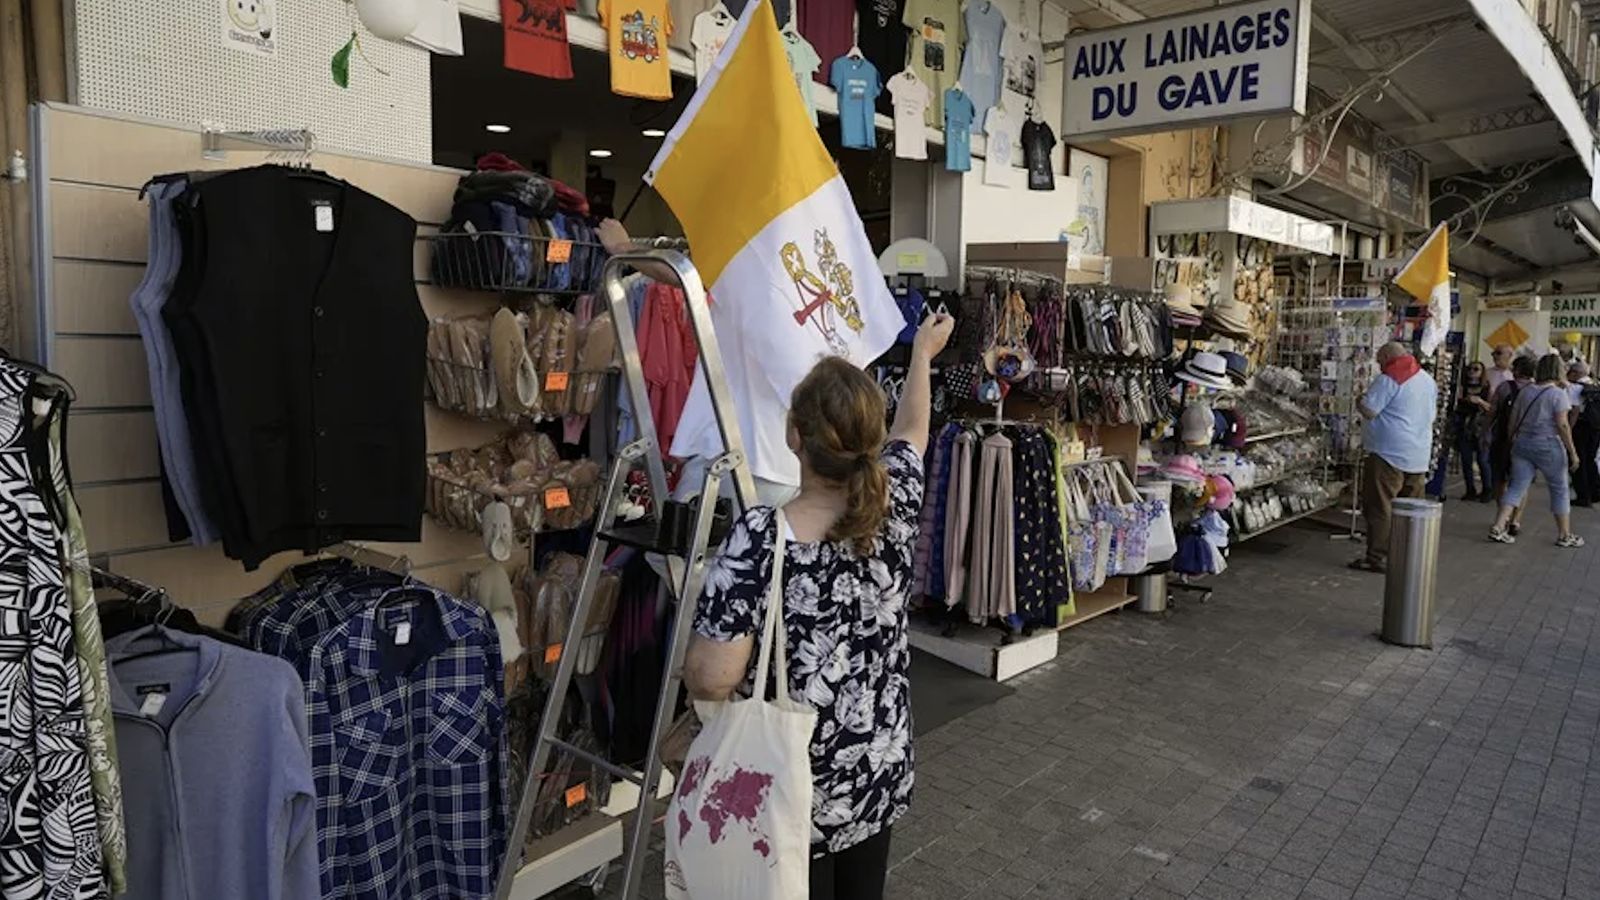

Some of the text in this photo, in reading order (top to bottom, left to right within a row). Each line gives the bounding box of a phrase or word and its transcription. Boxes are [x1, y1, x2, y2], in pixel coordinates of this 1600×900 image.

[1072, 8, 1290, 80] AUX LAINAGES
[1092, 63, 1260, 121] DU GAVE
[1552, 298, 1597, 311] SAINT
